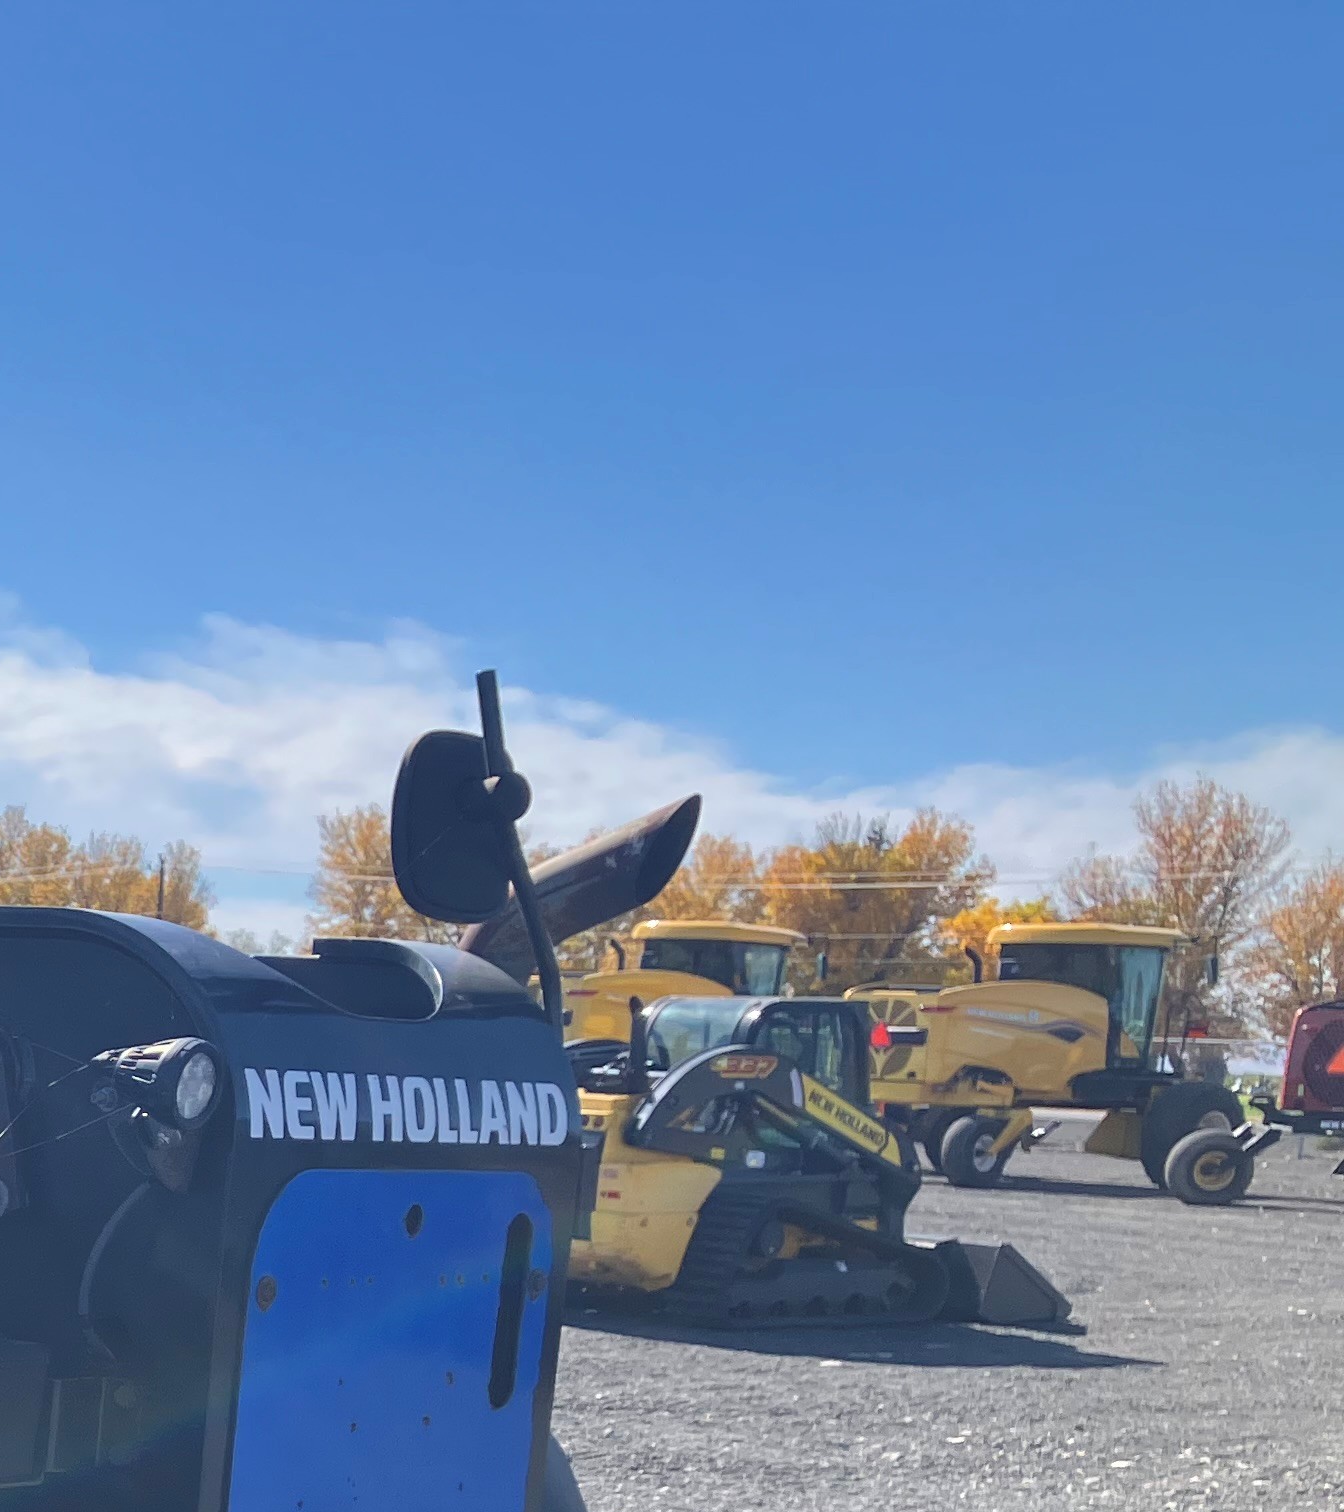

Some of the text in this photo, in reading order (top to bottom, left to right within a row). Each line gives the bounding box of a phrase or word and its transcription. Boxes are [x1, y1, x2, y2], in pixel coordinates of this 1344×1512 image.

[243, 1067, 569, 1146] NEW HOLLAND
[808, 1089, 884, 1147] NEW HOLLAND
